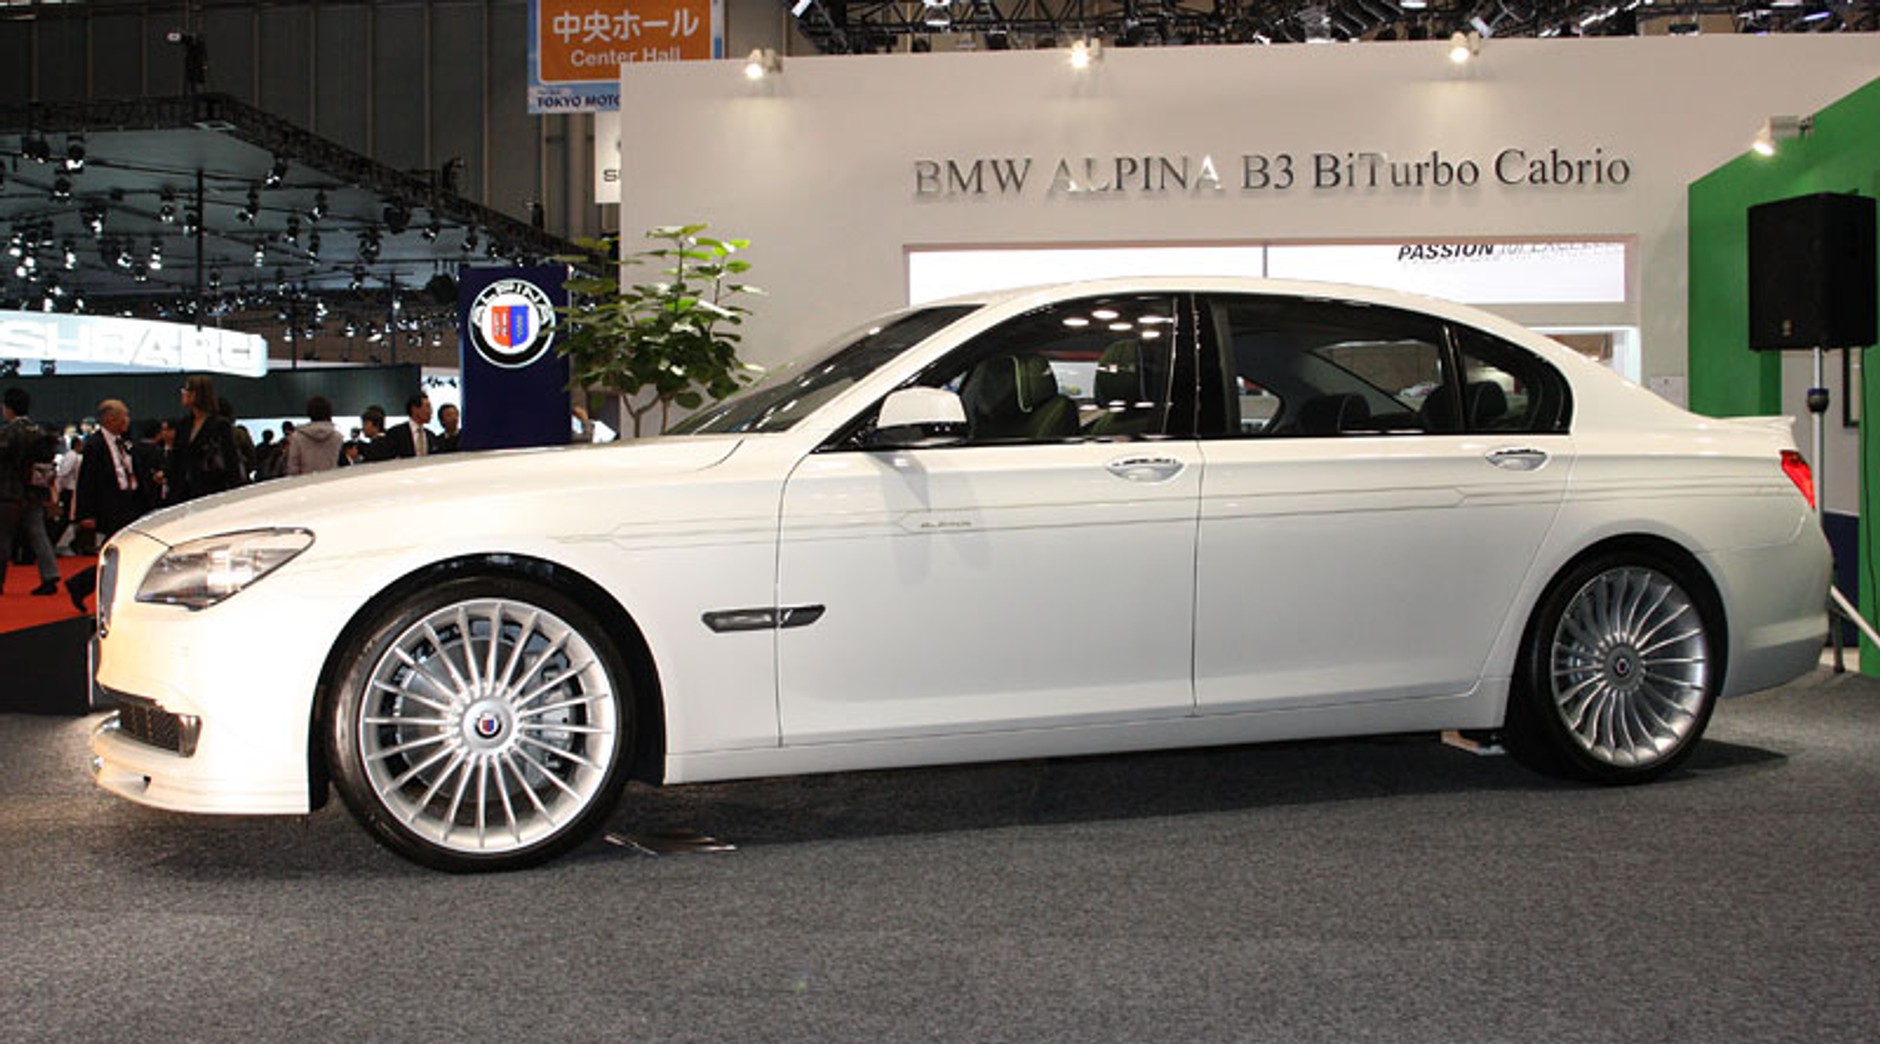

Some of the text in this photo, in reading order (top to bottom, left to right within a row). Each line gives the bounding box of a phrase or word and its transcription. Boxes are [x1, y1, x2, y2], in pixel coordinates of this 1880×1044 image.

[553, 8, 699, 43] 中央ホール
[571, 45, 681, 67] Center Hall
[537, 95, 581, 108] TOKYO
[914, 148, 1630, 196] BMW ALPINA B3 BiTurbo Cabrio
[1397, 243, 1494, 261] PASSION
[473, 282, 551, 327] ALPINA
[0, 310, 268, 375] SUBARU
